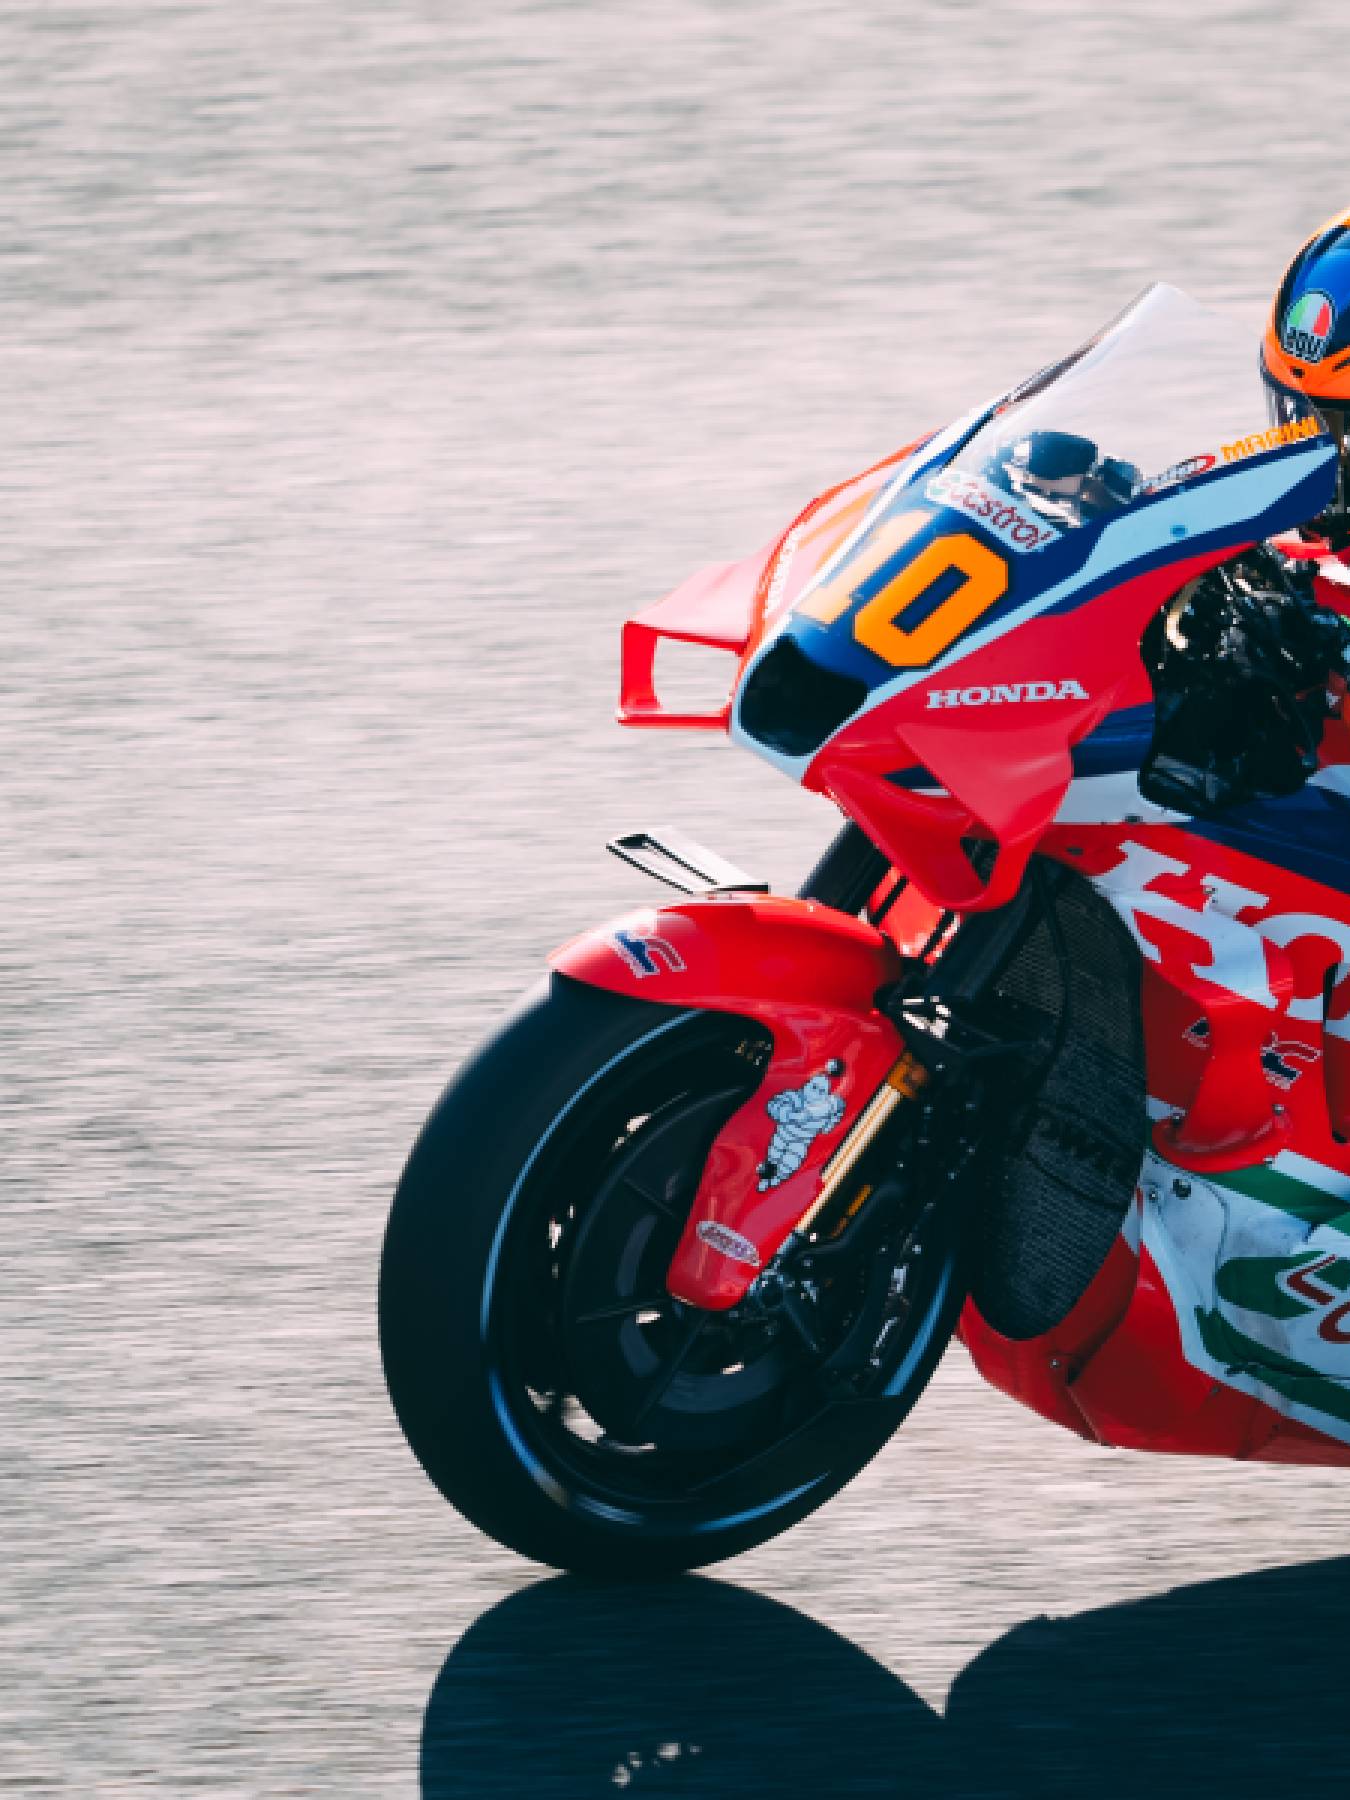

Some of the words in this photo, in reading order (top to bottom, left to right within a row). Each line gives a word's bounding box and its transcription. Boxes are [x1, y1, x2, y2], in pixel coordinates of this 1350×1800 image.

[1220, 414, 1321, 463] MARINI
[792, 509, 1009, 667] 10
[926, 679, 1089, 710] HONDA
